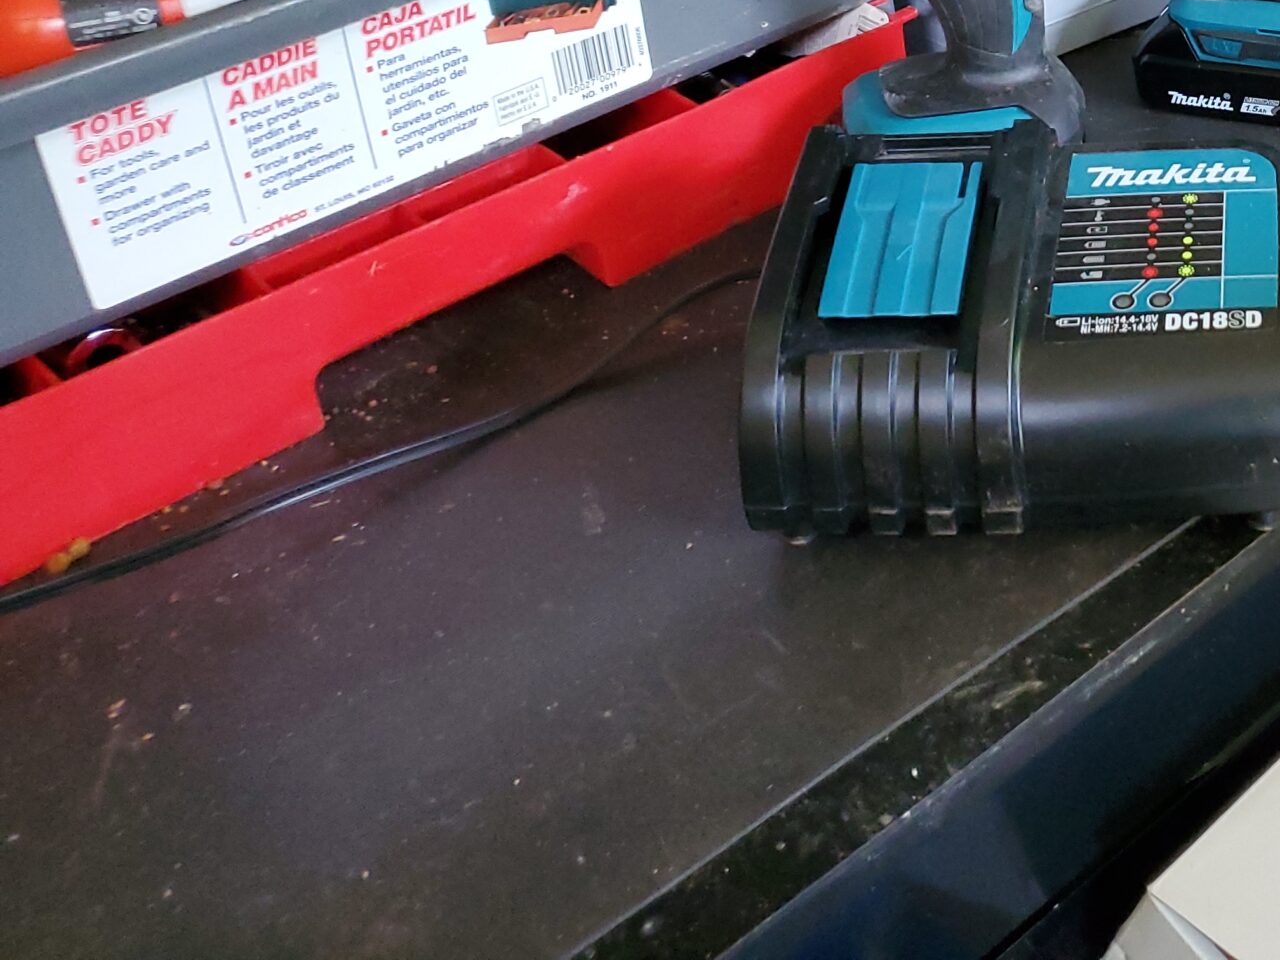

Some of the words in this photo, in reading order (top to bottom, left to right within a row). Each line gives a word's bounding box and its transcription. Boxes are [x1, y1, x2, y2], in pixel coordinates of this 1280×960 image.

[362, 0, 423, 35] CAJA
[366, 4, 476, 58] PORTATIL
[222, 37, 318, 86] CADDIE
[377, 54, 406, 70] Para
[380, 45, 462, 82] herramientas,
[382, 65, 440, 94] utensilios
[443, 55, 469, 73] para
[229, 89, 247, 111] A
[253, 61, 318, 102] MAIN
[385, 94, 397, 105] el
[399, 75, 447, 100] cuidado
[450, 66, 467, 80] del
[428, 88, 450, 101] etc.
[582, 90, 598, 101] NO.
[600, 81, 618, 93] 1911
[71, 100, 147, 141] TOTE
[240, 104, 272, 122] Pour
[275, 96, 295, 108] les
[243, 121, 263, 134] les
[267, 100, 321, 127] produits
[324, 92, 340, 103] du
[392, 111, 432, 132] Gaveta
[435, 101, 456, 116] con
[395, 100, 490, 144] compartimientos
[78, 112, 175, 164] CADDY
[247, 126, 285, 149] jardin
[288, 119, 302, 131] et
[251, 127, 319, 158] davantage
[397, 141, 424, 158] para
[426, 117, 479, 145] organizar
[89, 165, 115, 178] For
[95, 168, 146, 194] garden
[149, 154, 181, 171] care
[184, 140, 211, 157] and
[255, 155, 289, 174] Tiroir
[293, 142, 324, 159] avec
[259, 143, 355, 187] compartiments
[262, 187, 279, 199] de
[282, 155, 355, 191] classement
[98, 185, 137, 204] more
[103, 195, 157, 221] Drawer
[108, 188, 211, 234] compartments
[111, 233, 133, 246] for
[137, 202, 211, 237] organizing
[1165, 310, 1262, 331] DC18SD
